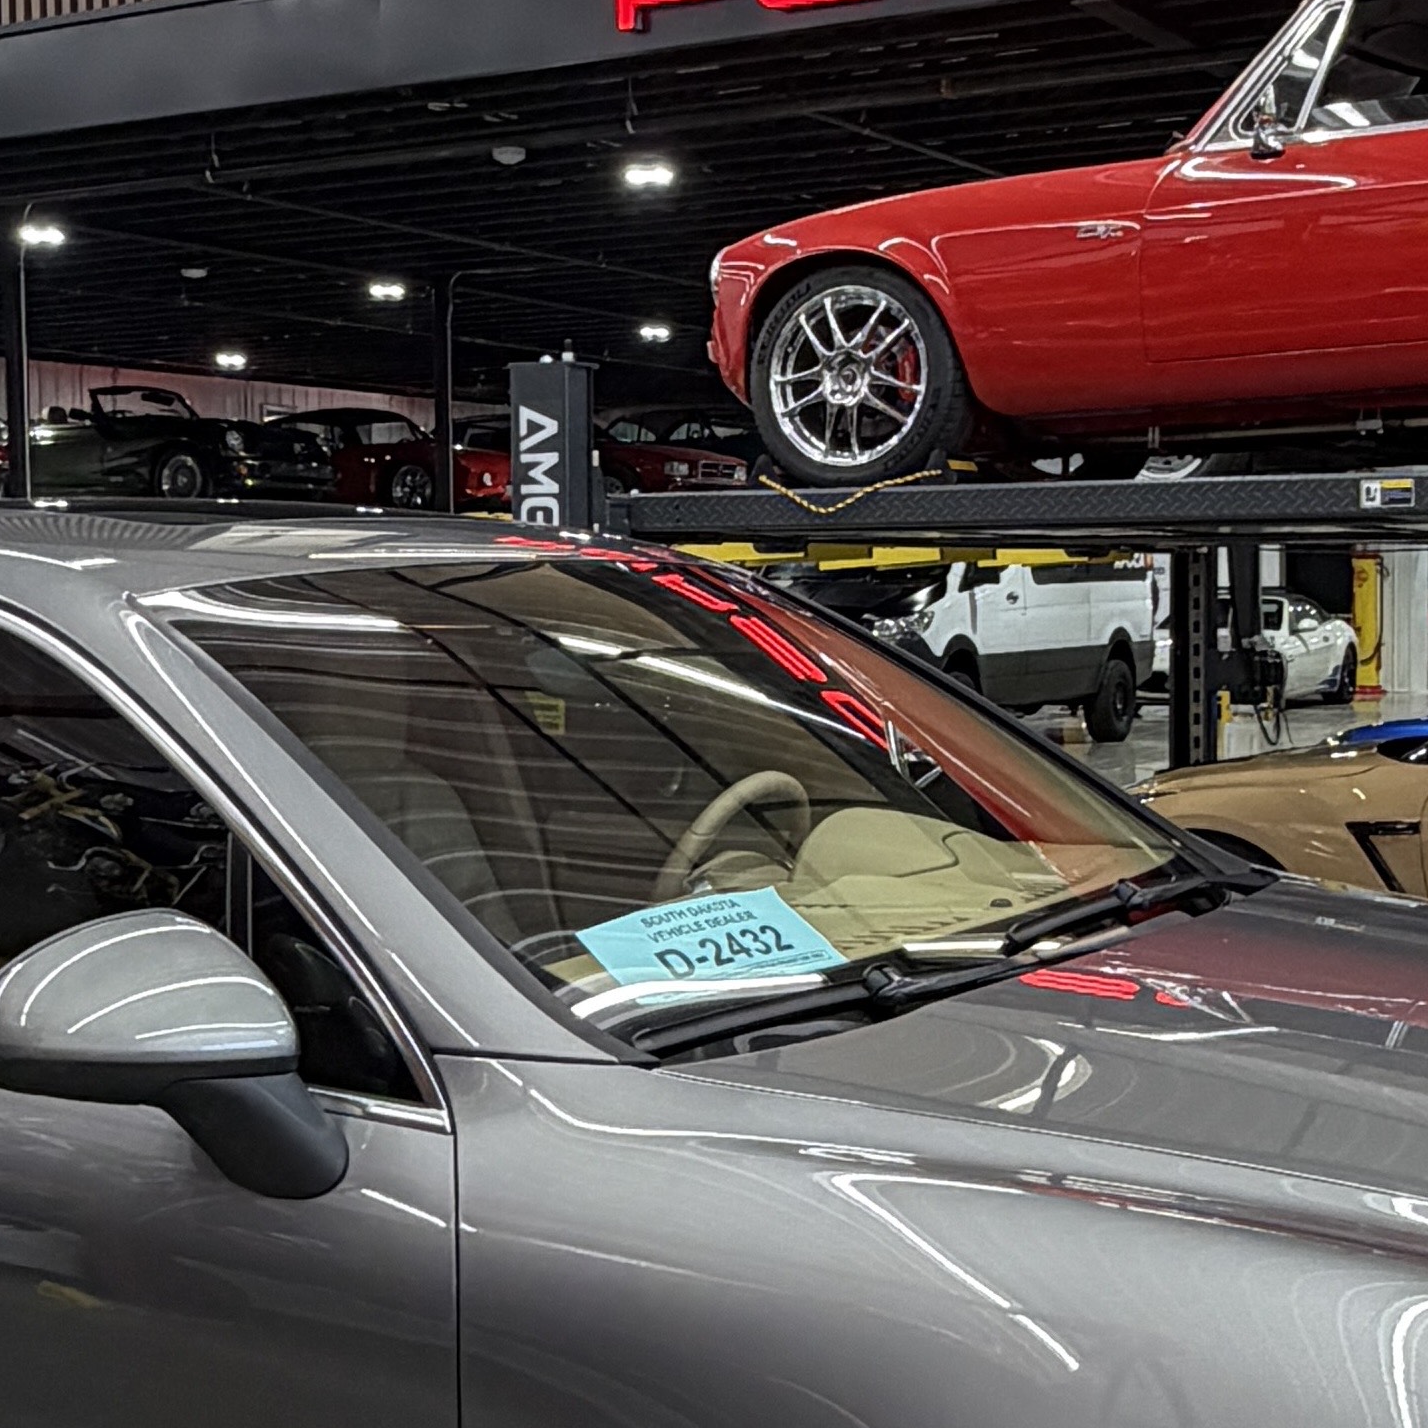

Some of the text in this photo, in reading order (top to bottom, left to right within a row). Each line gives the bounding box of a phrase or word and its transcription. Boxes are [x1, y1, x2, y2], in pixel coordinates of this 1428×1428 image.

[519, 405, 560, 526] AMG
[640, 898, 742, 929] SOUTH DAKOTA
[647, 910, 758, 944] VEHICLE DEALER
[653, 924, 795, 980] D-2432
